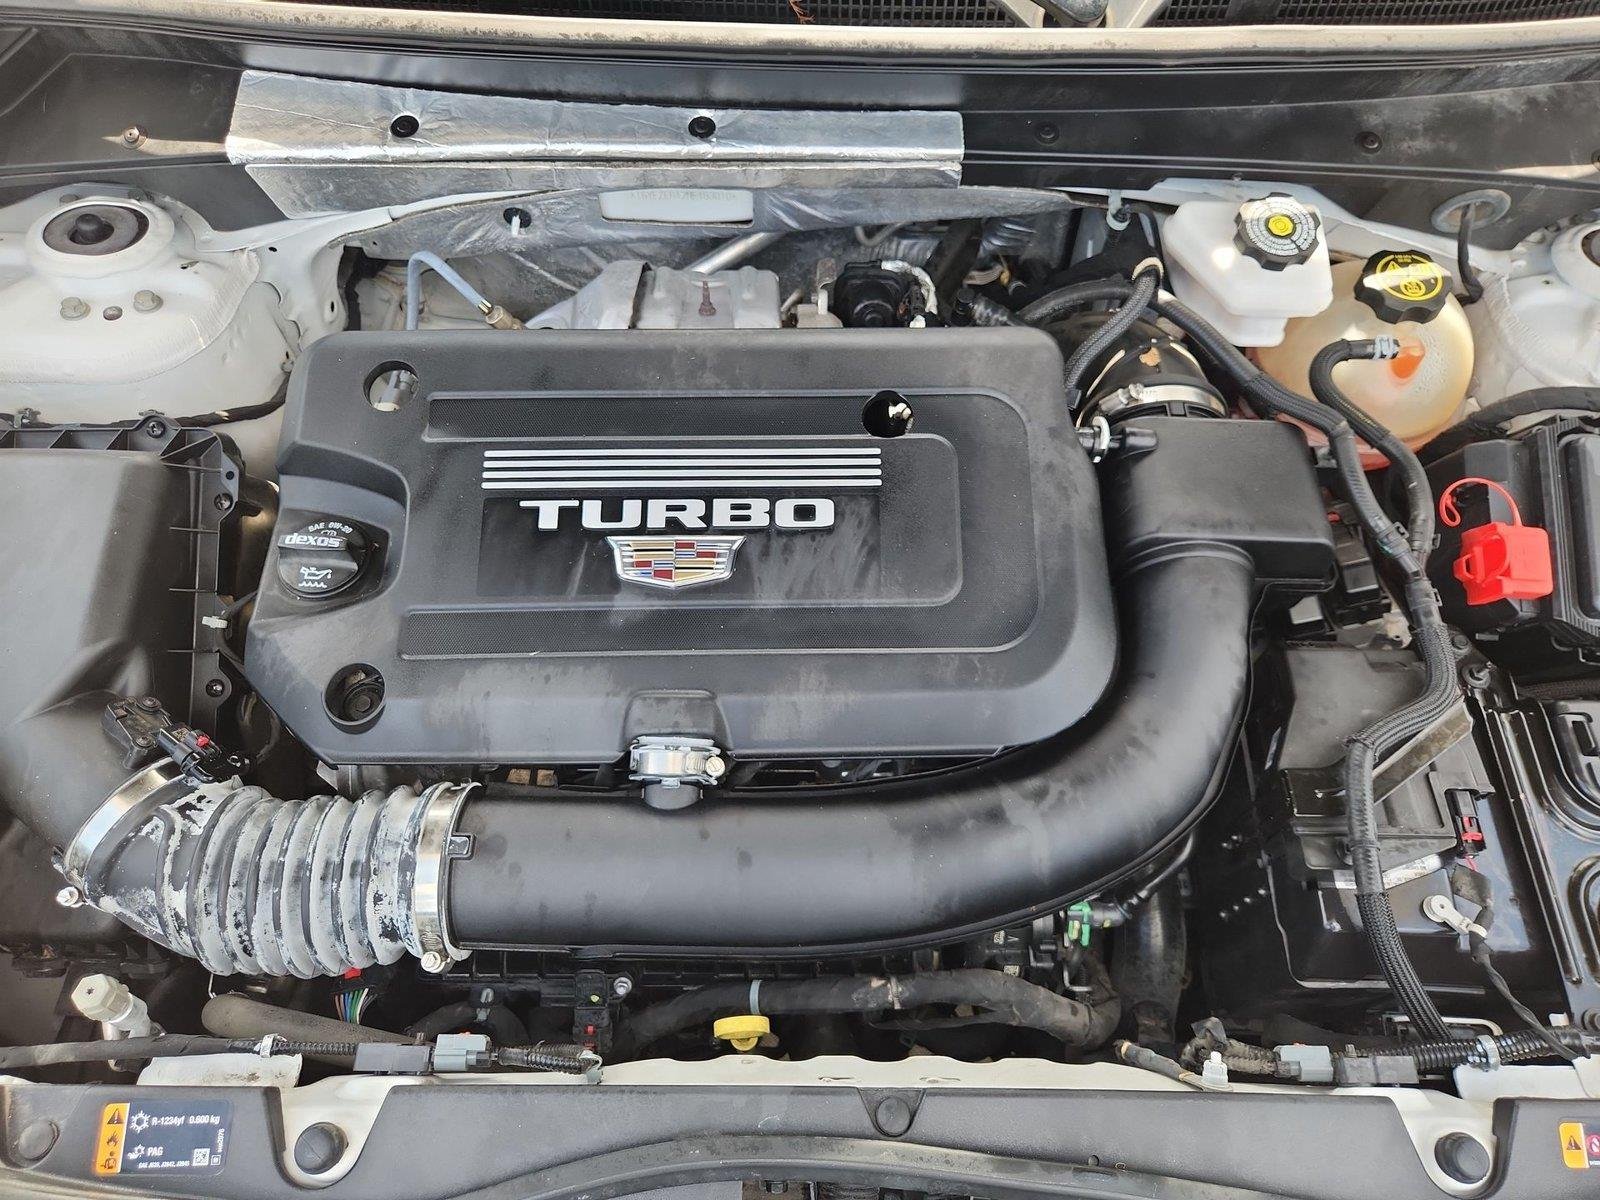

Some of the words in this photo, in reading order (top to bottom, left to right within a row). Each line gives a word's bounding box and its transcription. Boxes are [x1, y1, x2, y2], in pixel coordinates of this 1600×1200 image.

[519, 498, 835, 530] TURBO
[308, 522, 325, 532] SAE
[328, 521, 353, 534] 0W-20
[284, 532, 342, 548] dexos
[151, 1115, 185, 1126] R-1234yf
[210, 1114, 221, 1125] kg
[147, 1146, 164, 1157] PAG
